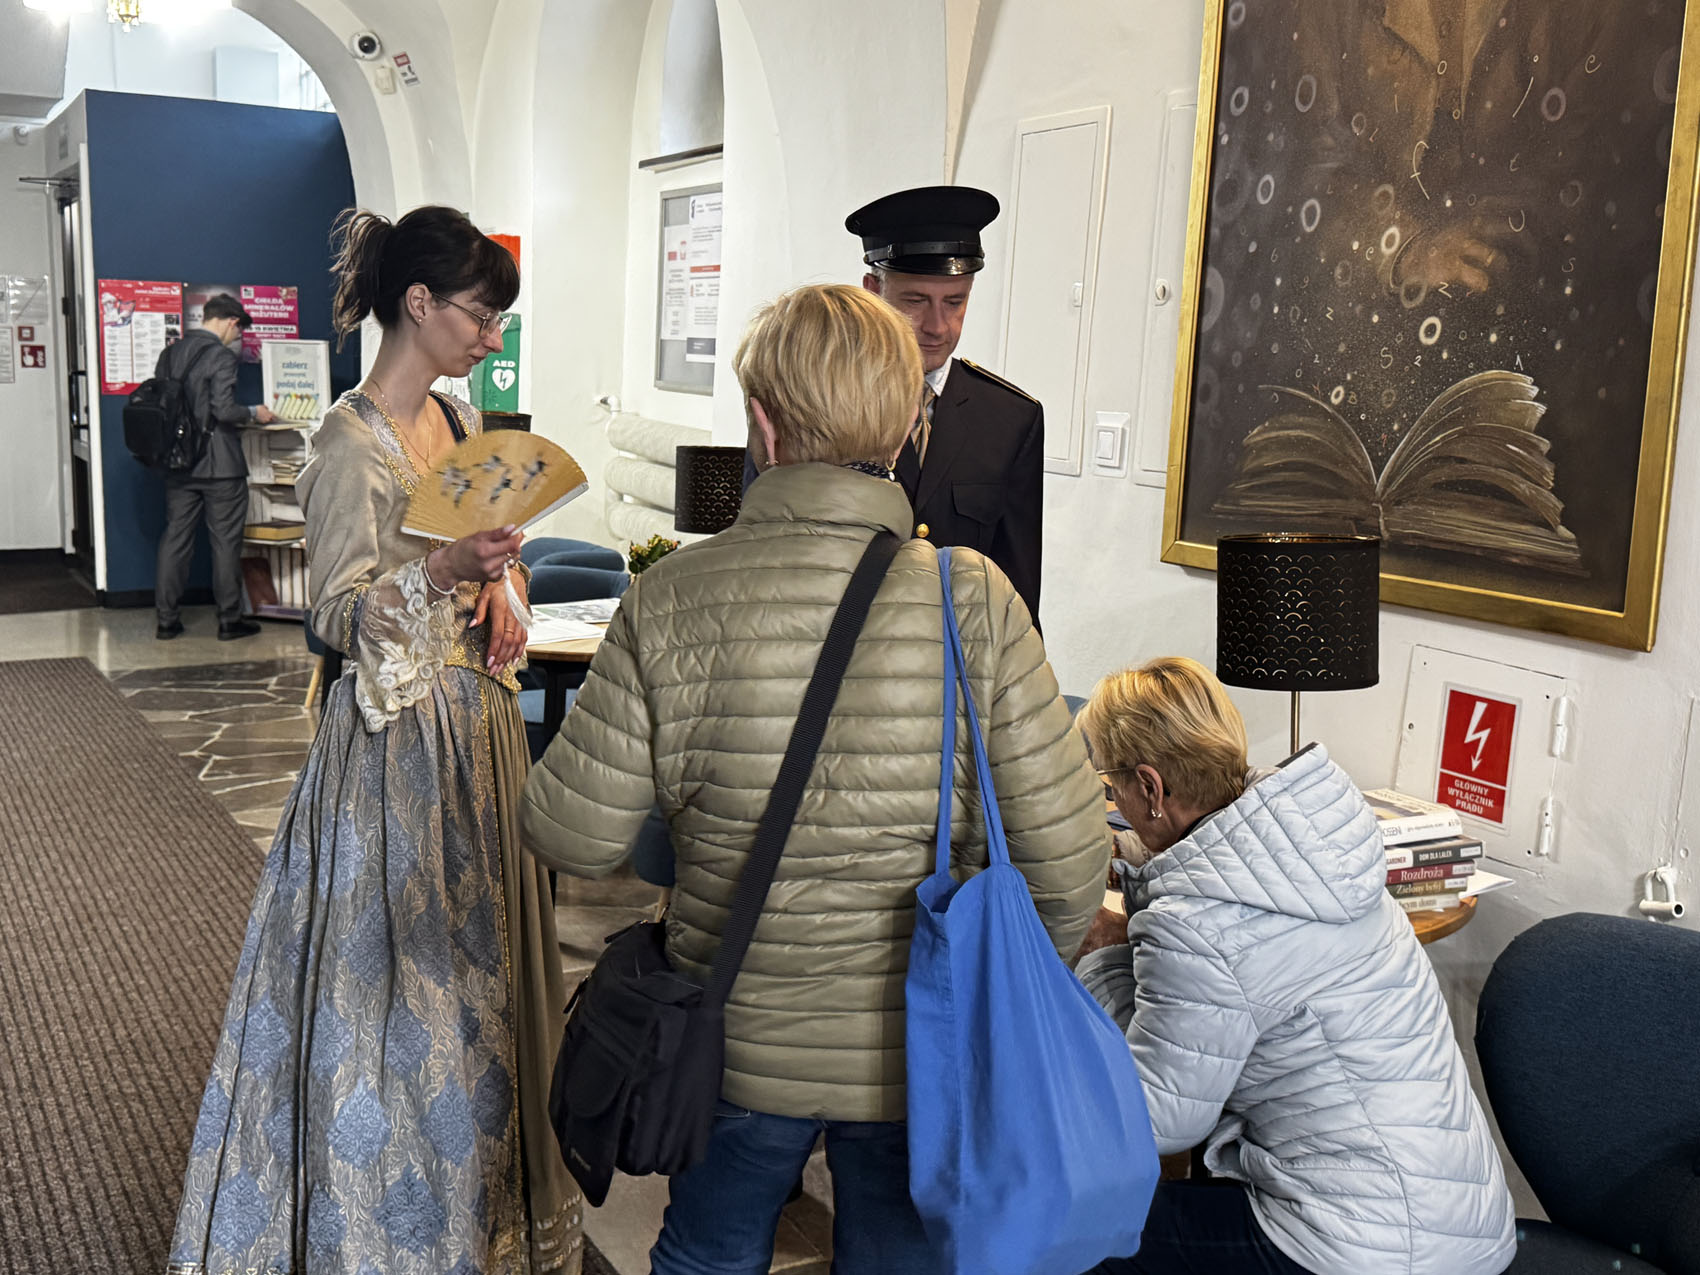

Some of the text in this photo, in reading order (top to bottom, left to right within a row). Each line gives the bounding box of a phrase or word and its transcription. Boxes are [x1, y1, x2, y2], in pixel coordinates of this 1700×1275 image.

[492, 359, 516, 368] AED
[1454, 779, 1489, 796] GŁÓWNY
[1447, 786, 1495, 808] WYŁĄCZNIK
[1455, 798, 1484, 815] PRĄDU
[1419, 852, 1430, 862] DOM
[1430, 851, 1438, 861] DLA
[1400, 866, 1444, 881] Rozdroża
